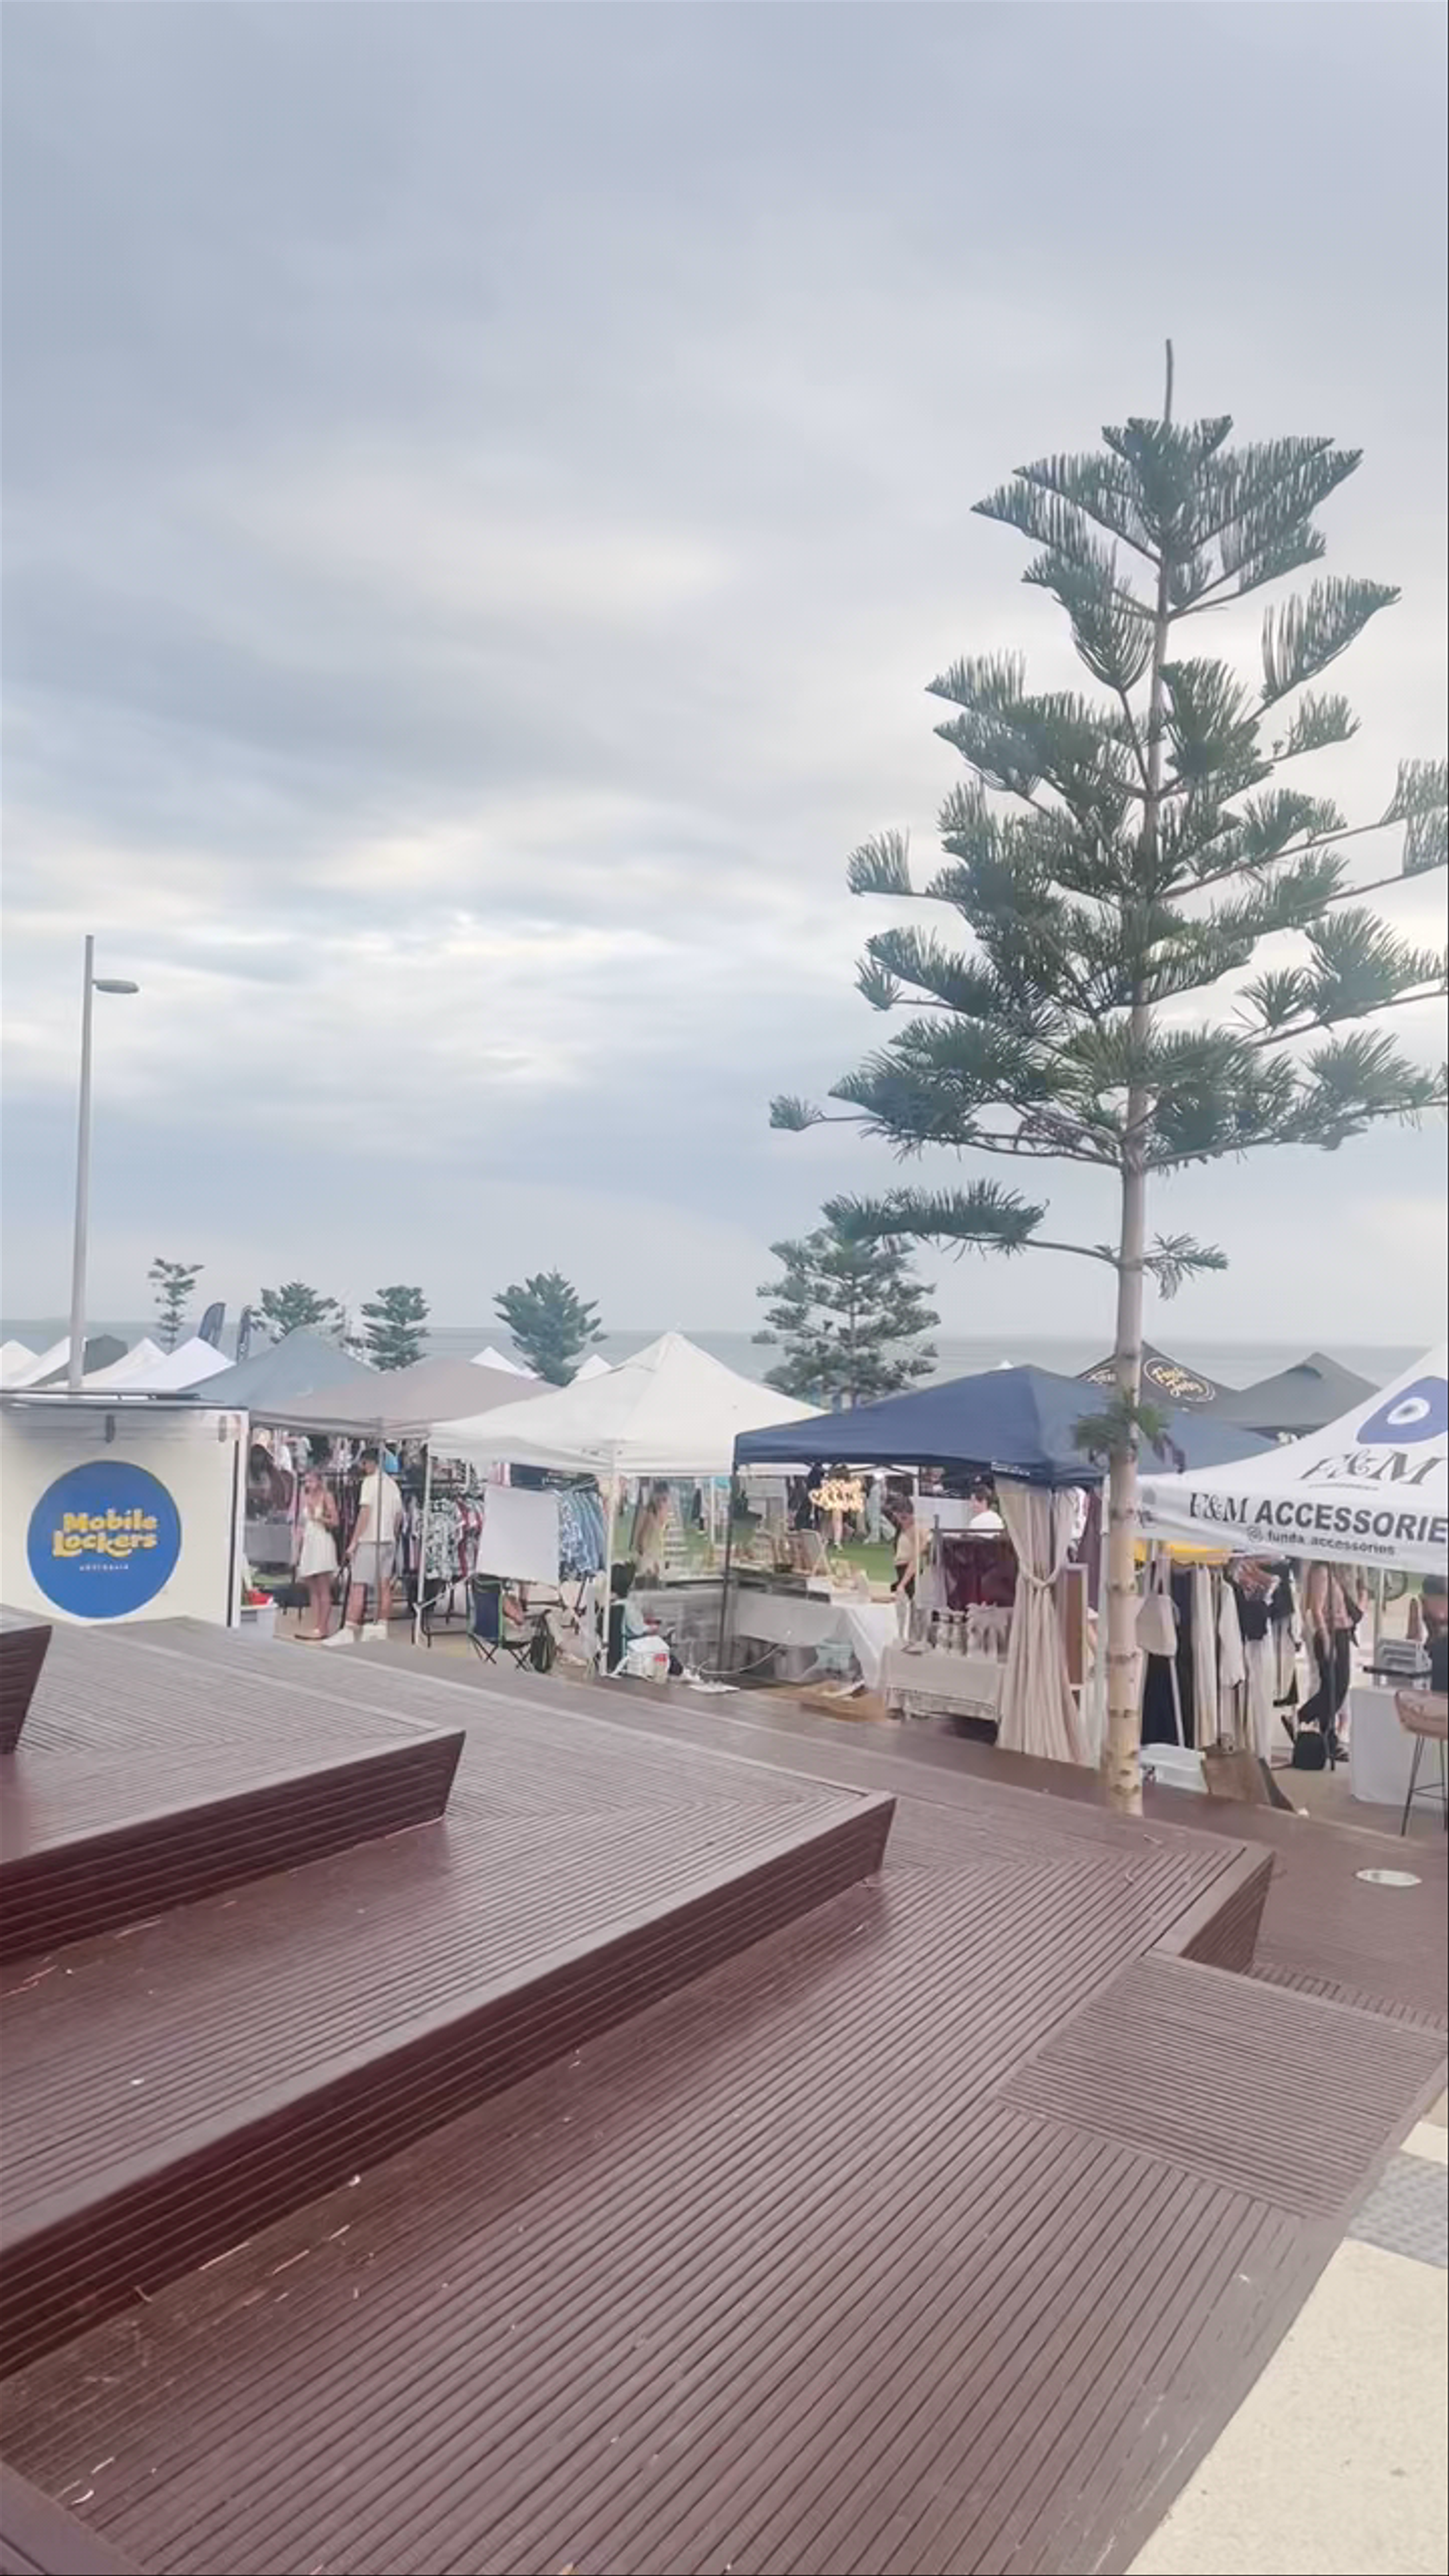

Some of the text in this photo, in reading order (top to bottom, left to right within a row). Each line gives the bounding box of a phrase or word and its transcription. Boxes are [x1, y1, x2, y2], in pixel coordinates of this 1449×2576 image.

[1297, 1448, 1446, 1486] F&M
[63, 1508, 157, 1533] Mobile
[1190, 1492, 1249, 1523] F&M
[53, 1530, 157, 1558] Lockers
